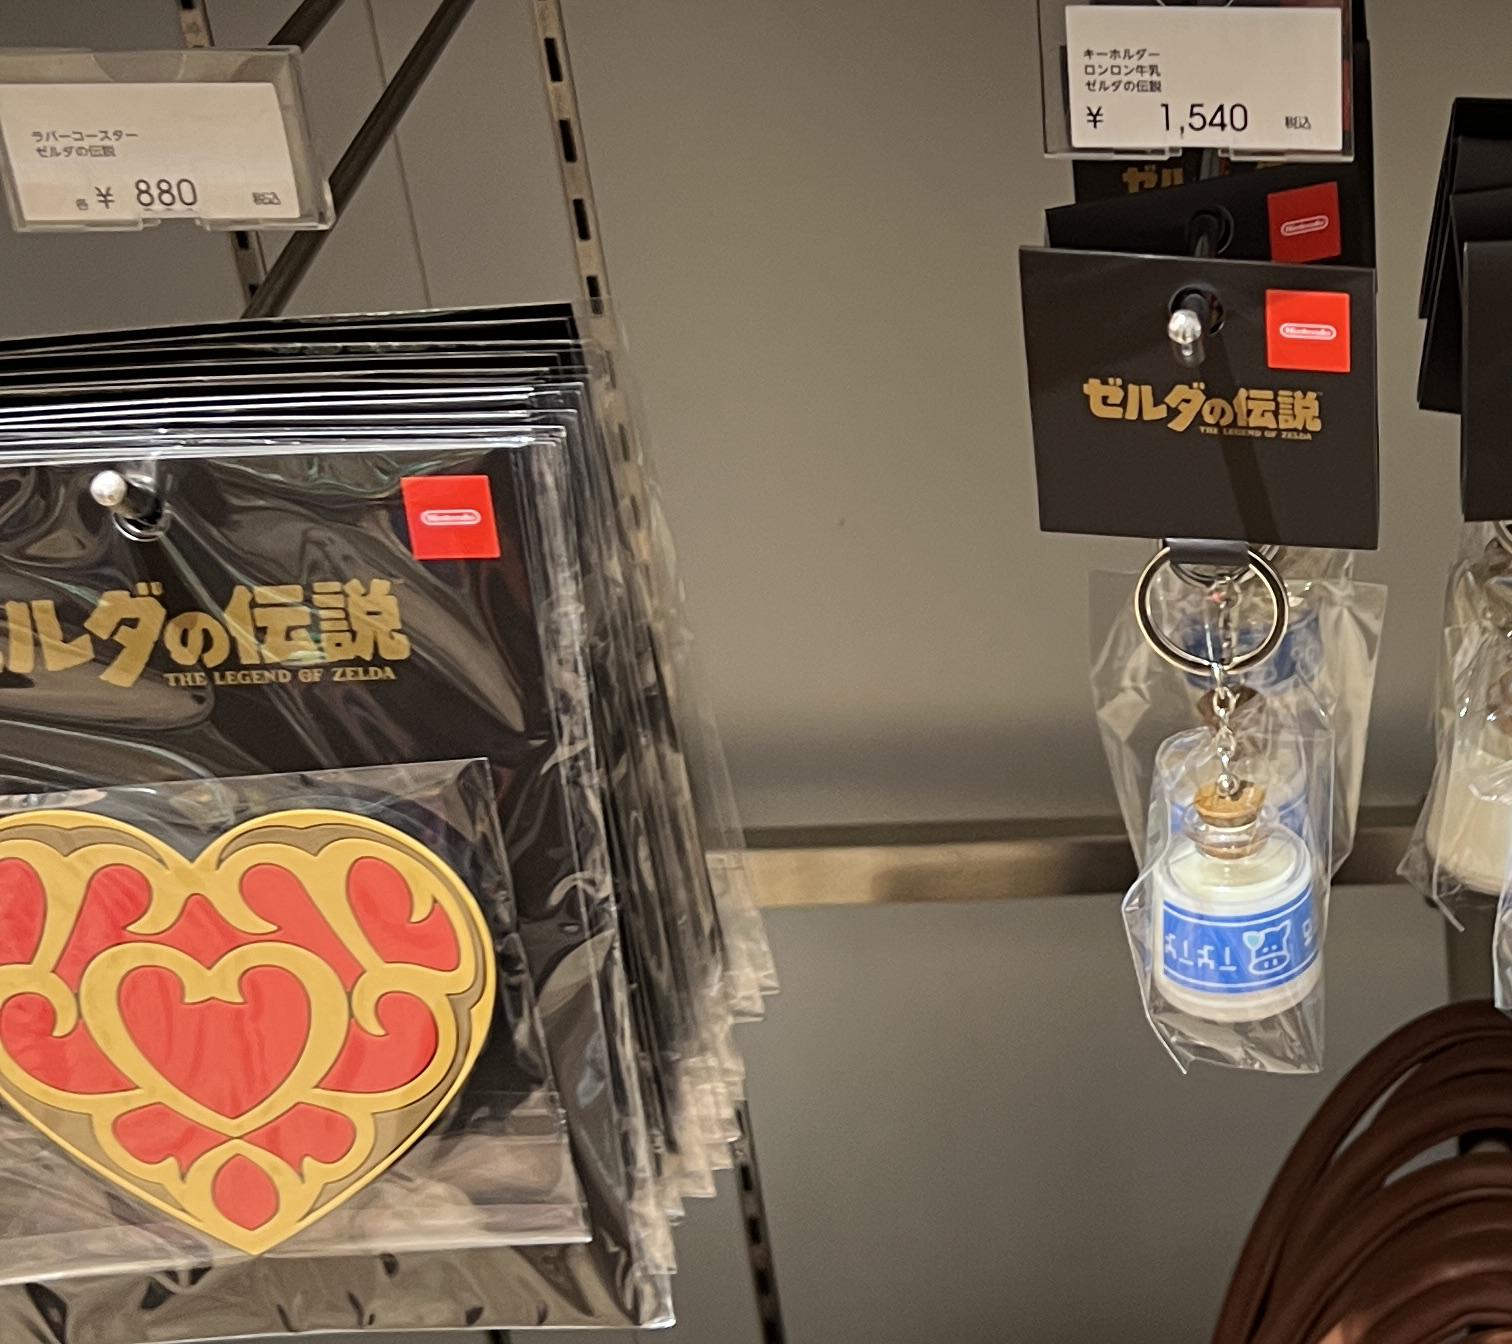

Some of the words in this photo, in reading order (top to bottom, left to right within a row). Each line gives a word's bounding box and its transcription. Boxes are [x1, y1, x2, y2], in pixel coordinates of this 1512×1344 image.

[1083, 48, 1160, 61] キーホルダー
[1084, 64, 1161, 77] ロンロン牛乳
[1085, 80, 1162, 93] ゼルダの伝説
[1160, 103, 1248, 137] 1,540
[31, 130, 138, 142] ラバーコースター
[36, 145, 117, 158] ゼルダの伝説
[134, 178, 198, 207] 880
[1083, 377, 1322, 432] ゼルダの伝説
[0, 578, 411, 688] ルダの伝説
[164, 670, 206, 687] THE
[215, 670, 291, 686] LEGEND
[299, 668, 323, 684] OF
[333, 666, 397, 682] ZELDA
